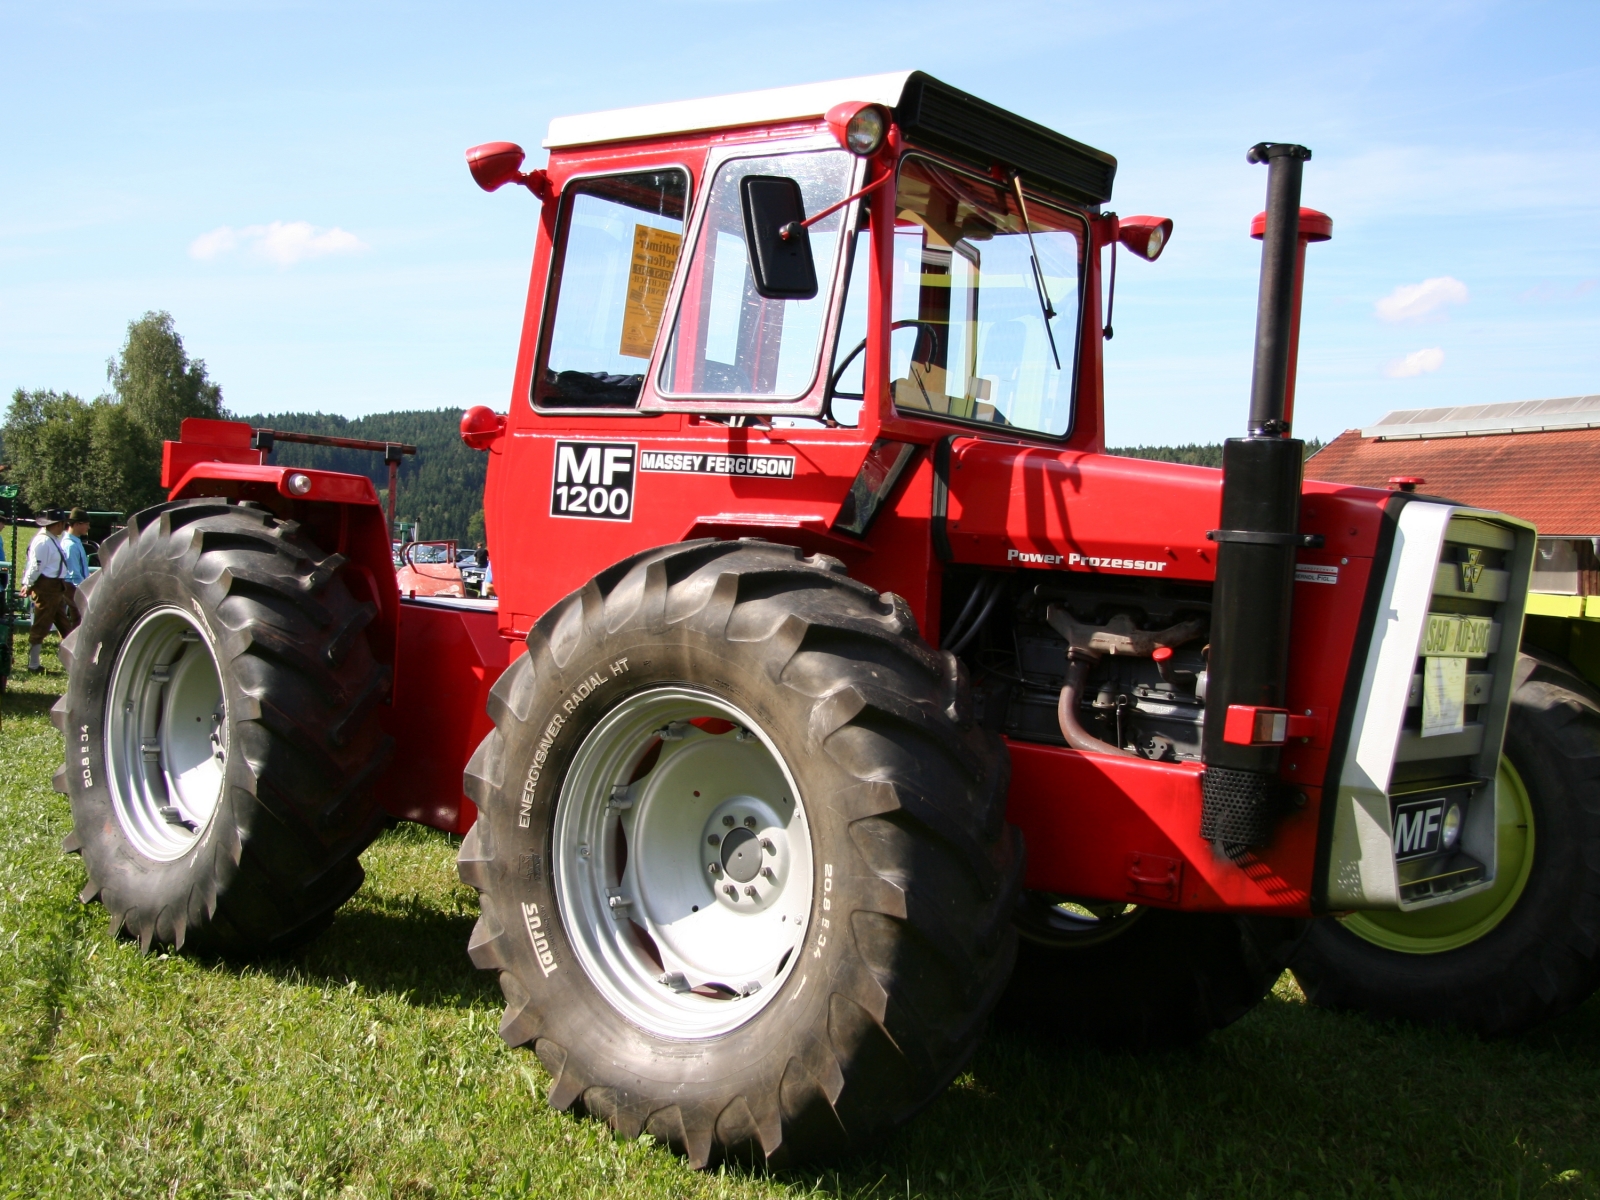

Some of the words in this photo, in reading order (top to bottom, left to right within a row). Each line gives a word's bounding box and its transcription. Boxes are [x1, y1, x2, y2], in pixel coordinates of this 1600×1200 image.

[557, 447, 633, 485] MF
[642, 453, 703, 472] MASSEY
[706, 455, 792, 476] FERGUSON
[555, 485, 629, 515] 1200
[1007, 548, 1064, 565] Power
[1068, 553, 1166, 572] Prozessor
[562, 670, 609, 714] RADIAL
[609, 657, 630, 678] HT
[81, 724, 89, 741] 34
[82, 757, 93, 788] 20.8
[1394, 807, 1442, 854] MF
[822, 863, 833, 911] 20.8
[521, 901, 558, 978] Taurus
